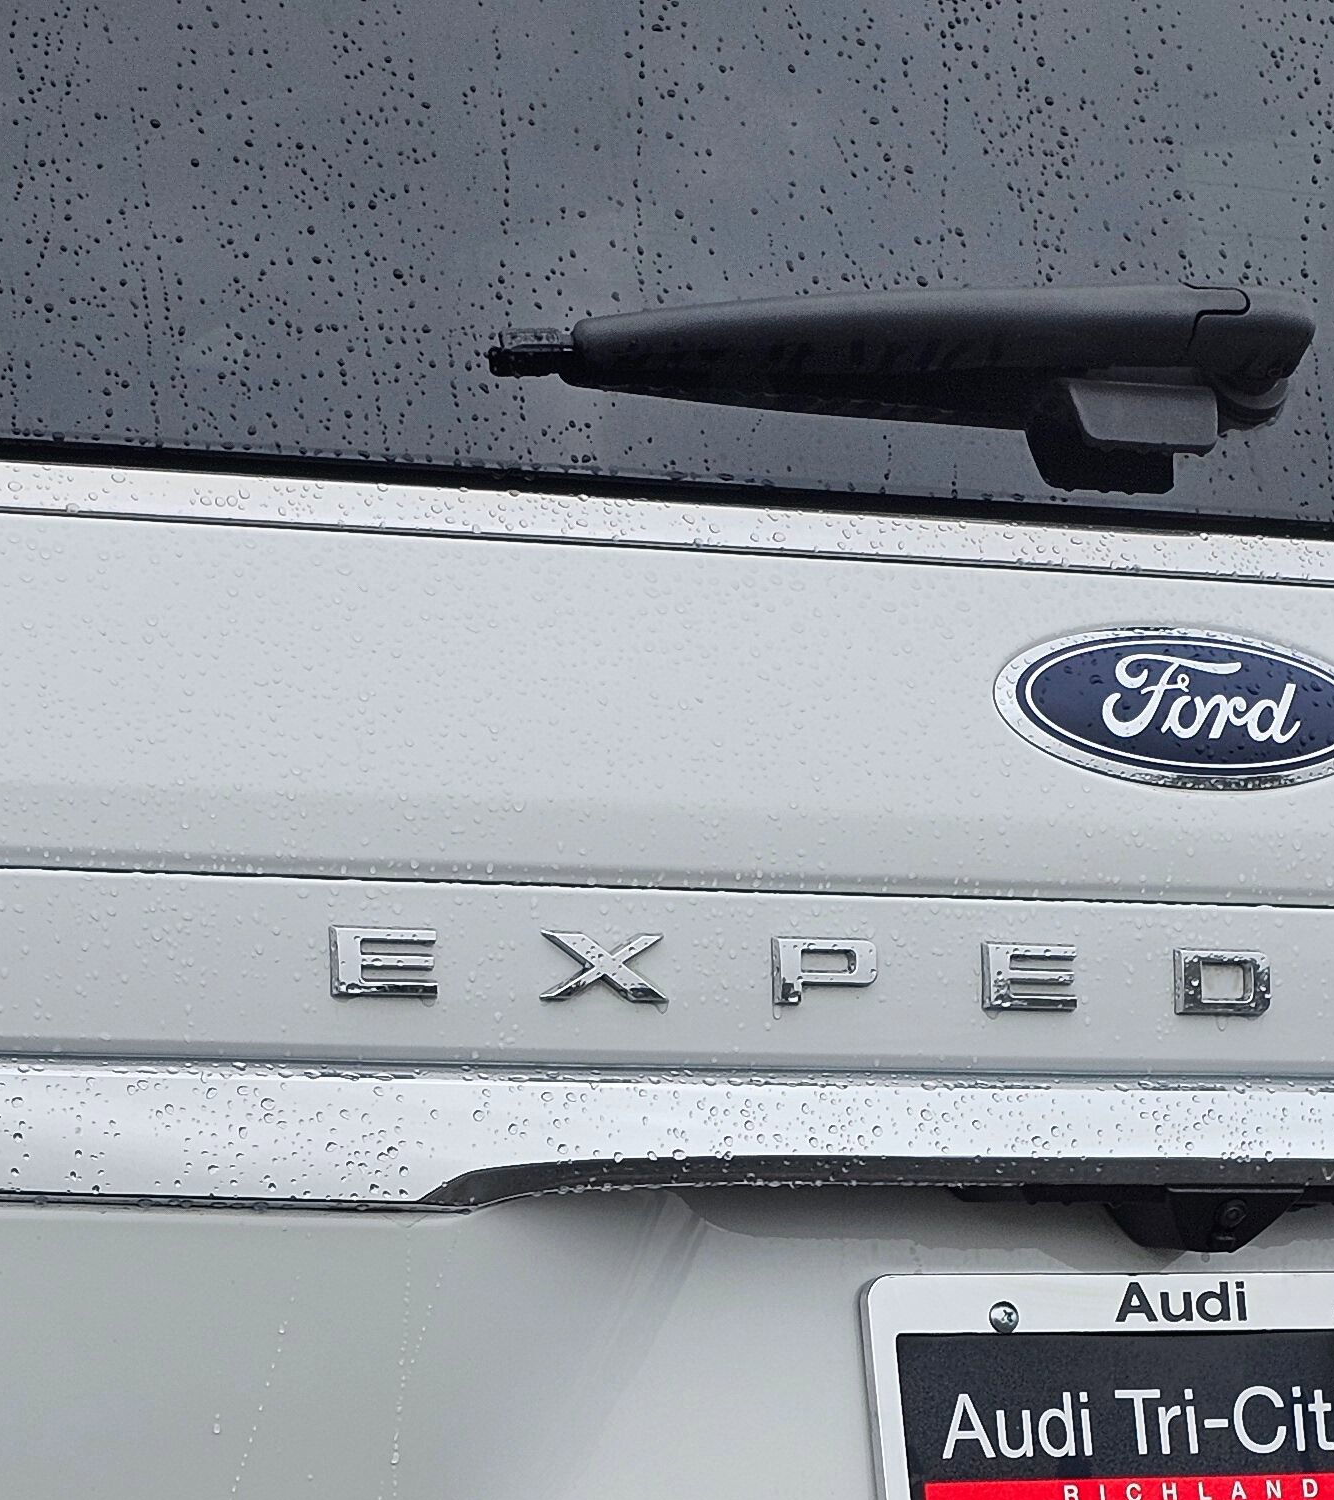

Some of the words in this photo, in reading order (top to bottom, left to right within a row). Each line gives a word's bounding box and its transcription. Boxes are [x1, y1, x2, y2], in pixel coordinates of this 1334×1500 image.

[1102, 653, 1301, 744] Ford
[1115, 1281, 1247, 1323] Audi
[942, 1391, 1094, 1460] Audi
